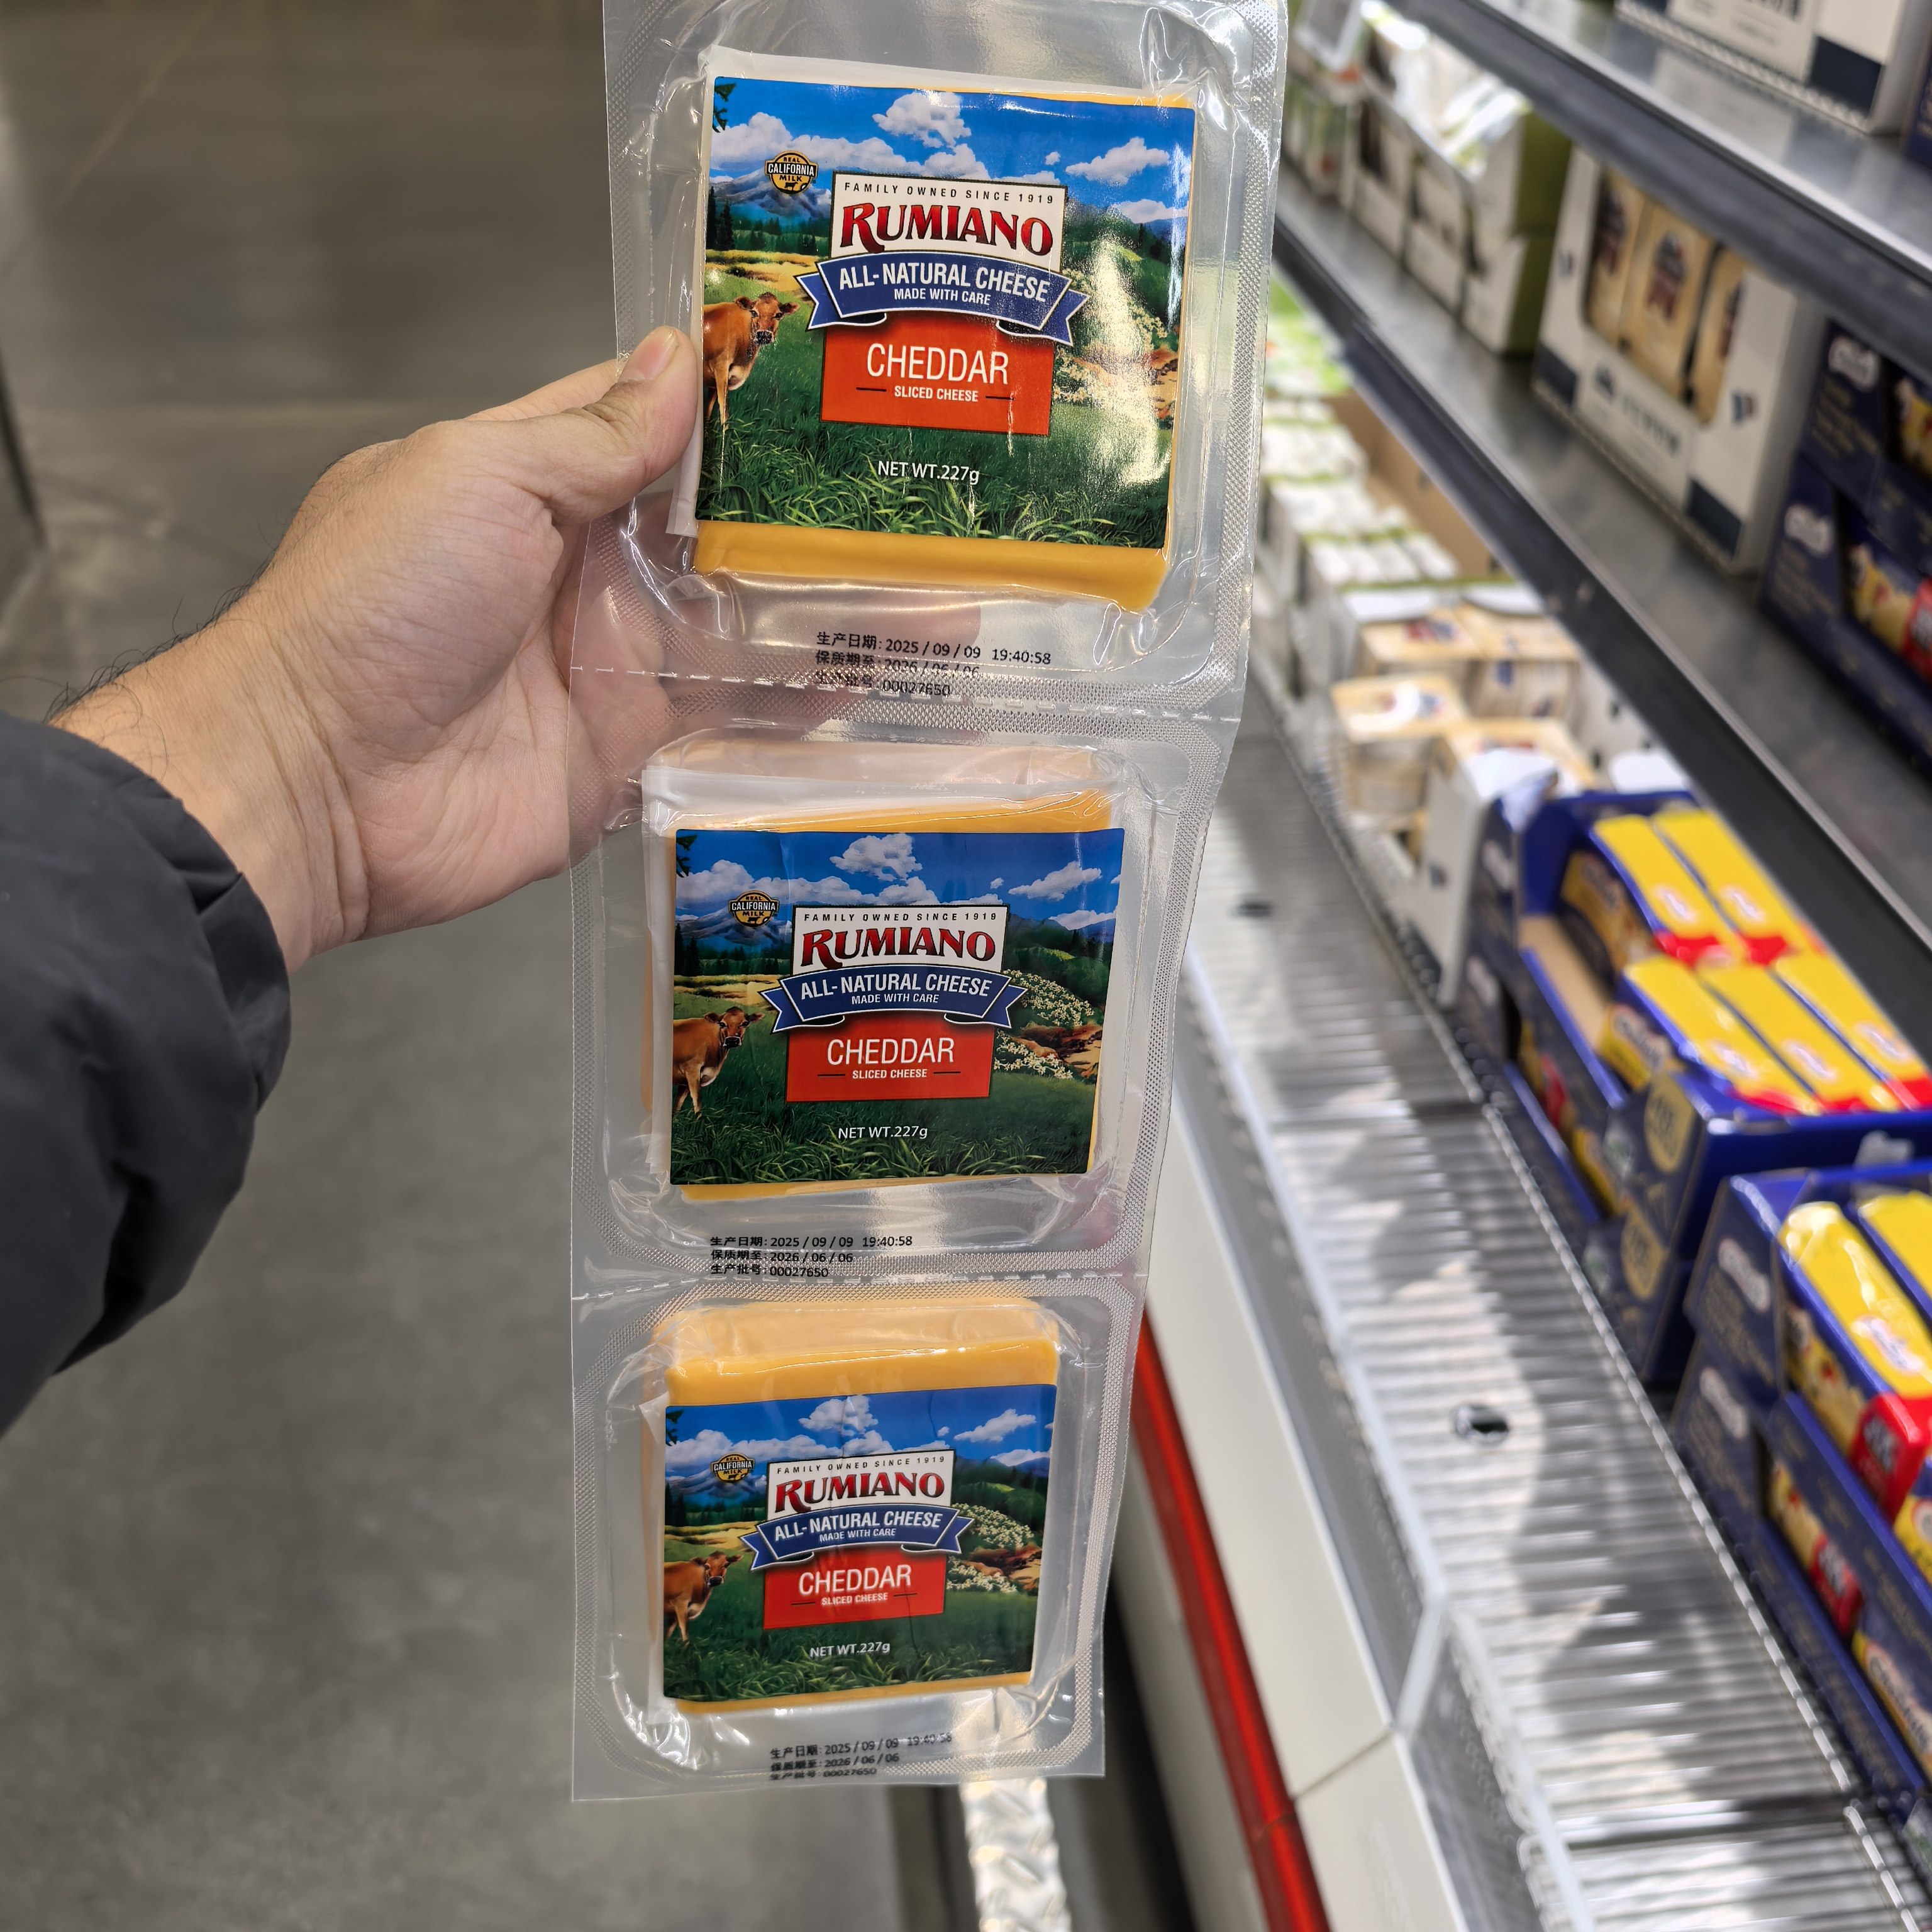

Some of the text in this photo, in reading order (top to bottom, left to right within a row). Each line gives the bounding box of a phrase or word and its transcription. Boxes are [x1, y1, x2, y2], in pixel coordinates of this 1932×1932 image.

[768, 164, 814, 176] CALIFORNIA
[845, 182, 1053, 204] FAMILY OWNED SINCE 1919
[840, 203, 1053, 256] RUMIANO
[840, 263, 1050, 302] ALL-NATURAL CHEESE
[894, 288, 991, 306] MADE WITH CARE
[867, 343, 1009, 385] CHEDDAR
[894, 386, 979, 402] SLICED CHEESE
[878, 460, 909, 476] NET
[992, 648, 1052, 665] 19:40:58
[731, 902, 776, 911] CALIFORNIA
[804, 913, 855, 922] FAMILY
[863, 913, 909, 921] OWNED
[917, 913, 958, 921] SINCE
[801, 926, 996, 969] RUMIANO
[801, 973, 993, 1000] ALL-NATURAL CHEESE
[852, 993, 940, 1005] MADE WITH CARE
[826, 1037, 955, 1065] CHEDDAR
[852, 1069, 928, 1079] SLICED CHEESE
[838, 1127, 865, 1139] NET
[862, 1236, 913, 1247] 19:40:58
[770, 1266, 828, 1277] 00027650
[714, 1461, 752, 1471] CALIFORNIA
[777, 1465, 821, 1474] FAMILY
[828, 1462, 868, 1470] OWNED
[875, 1458, 911, 1467] SINCE
[775, 1472, 945, 1513] RUMIANO
[774, 1511, 943, 1541] ALL-NATURAL CHEESE
[819, 1528, 897, 1543] MADE WITH CARE
[799, 1564, 912, 1596] CHEDDAR
[821, 1592, 888, 1606] SLICED CHEESE
[809, 1645, 835, 1658] NET
